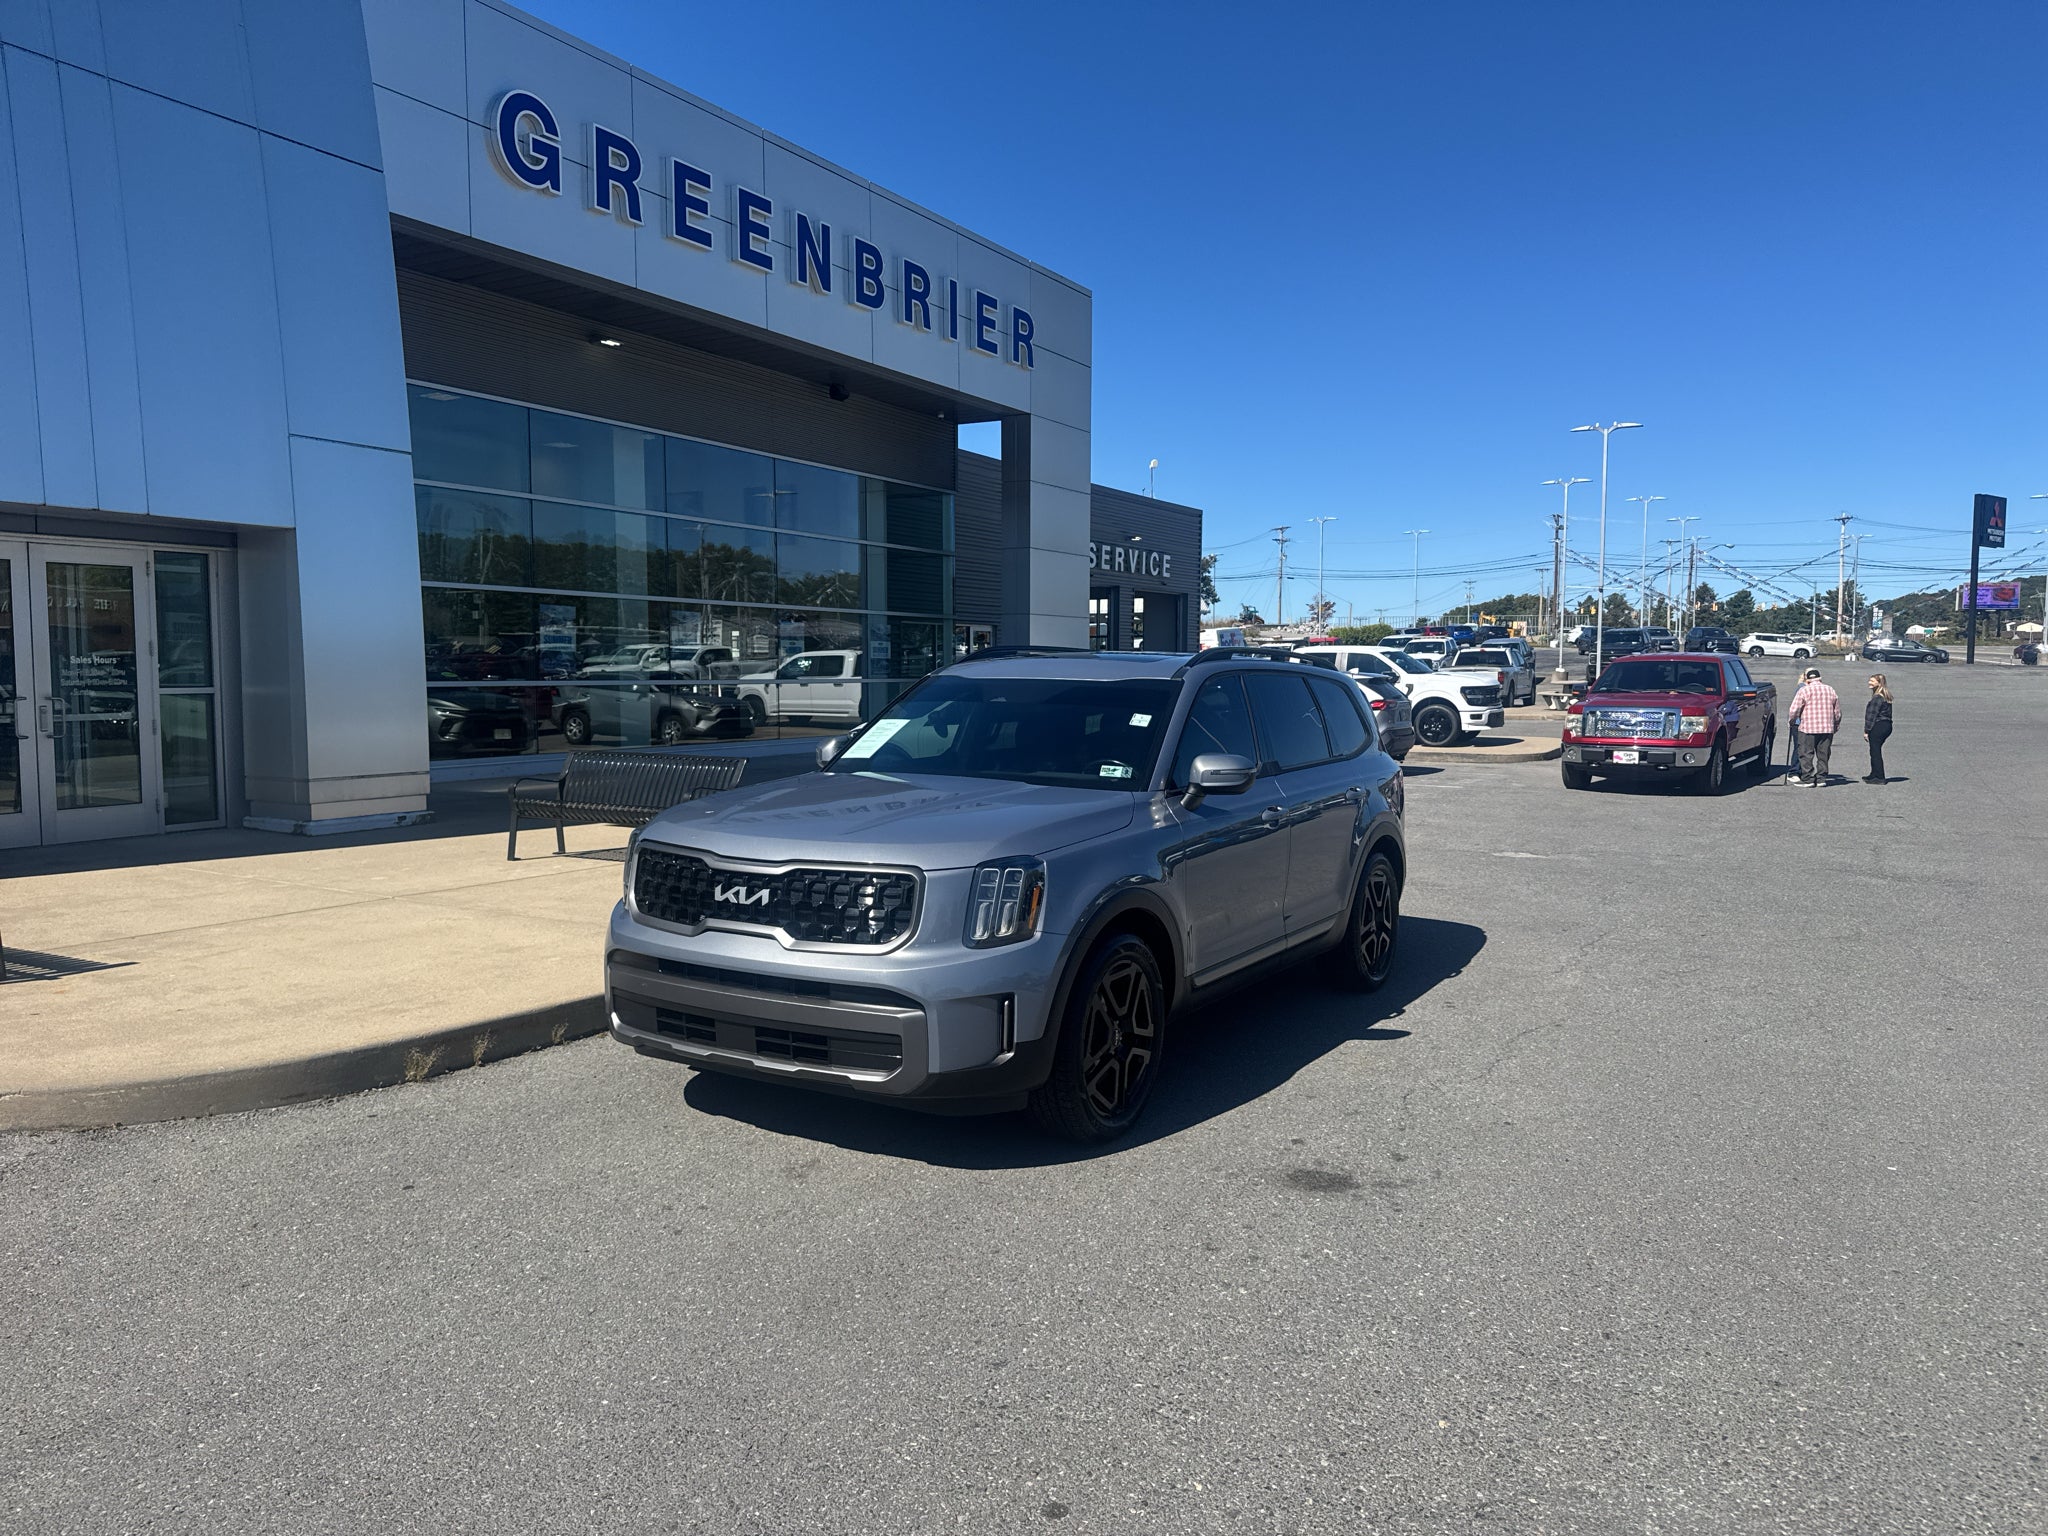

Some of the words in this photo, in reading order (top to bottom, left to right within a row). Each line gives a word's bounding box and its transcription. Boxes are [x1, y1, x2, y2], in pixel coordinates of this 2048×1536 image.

[492, 88, 1036, 369] GREENBRIER
[1089, 542, 1171, 578] SERVICE
[70, 655, 92, 664] Sales
[94, 655, 117, 664] Hours
[714, 882, 771, 907] KIA
